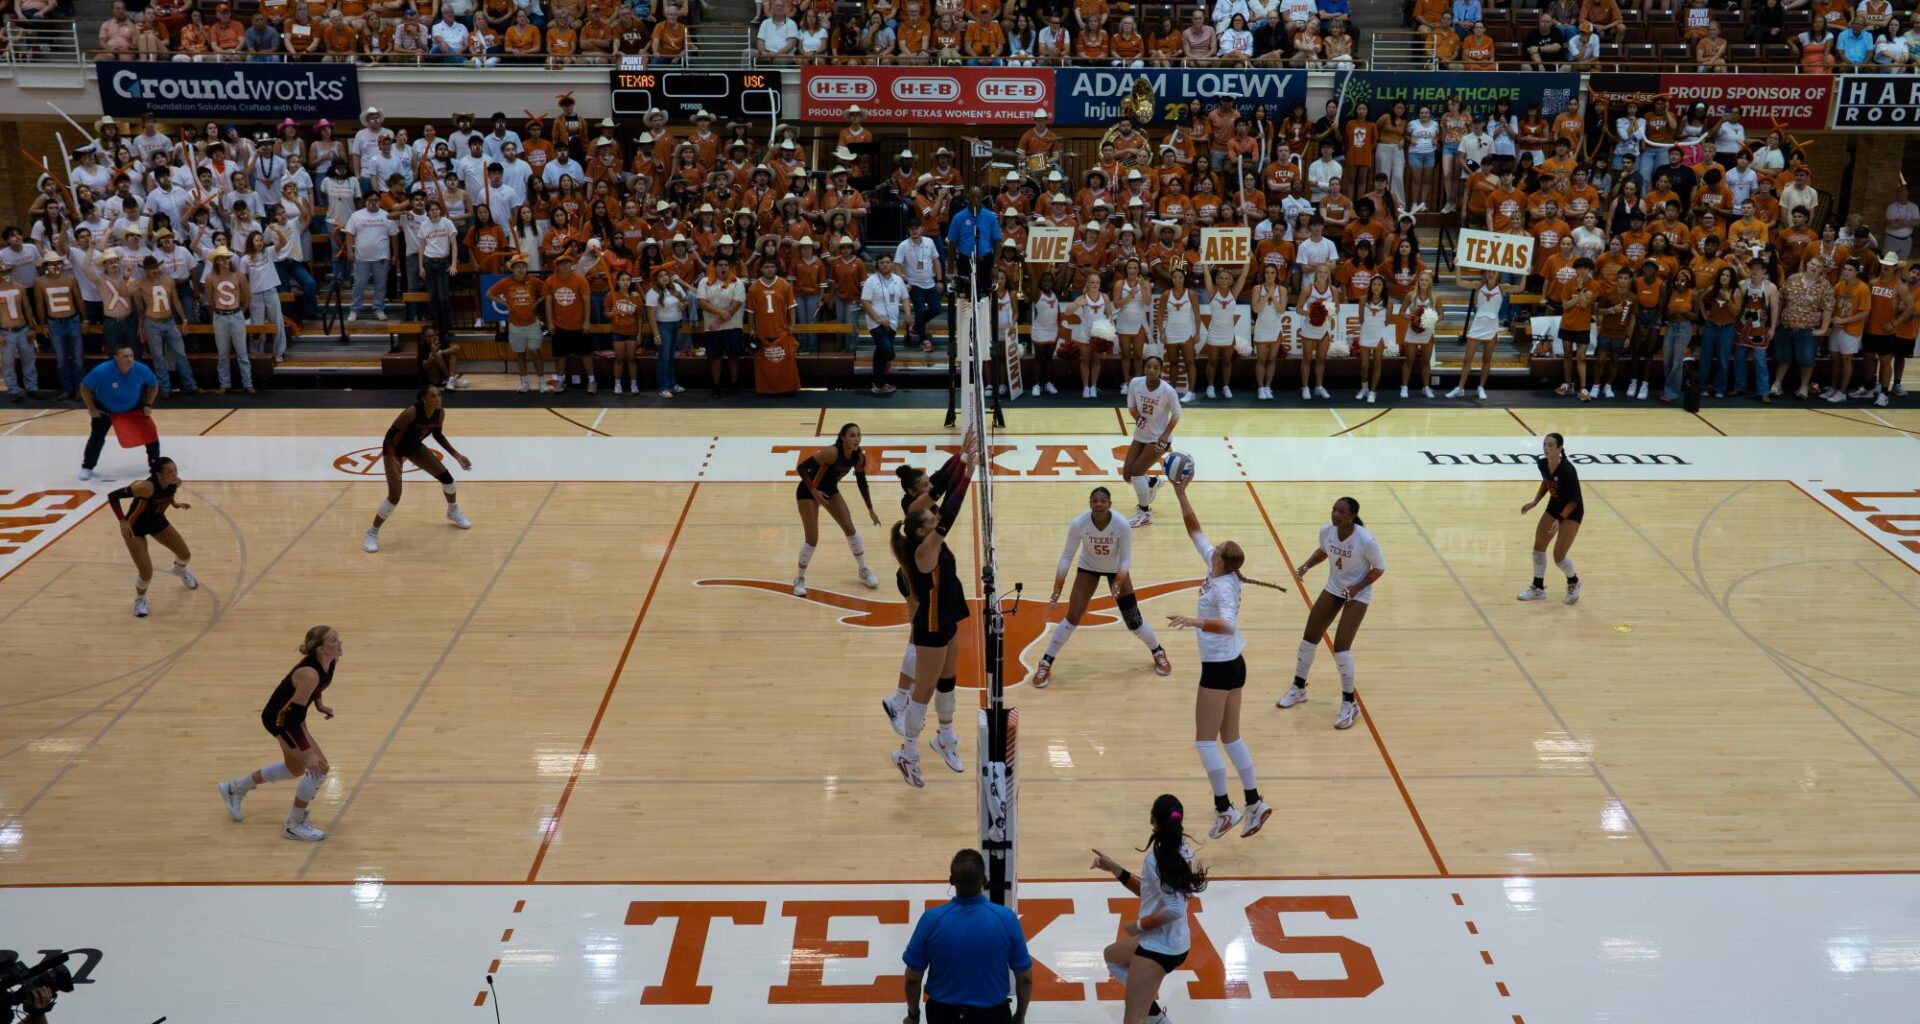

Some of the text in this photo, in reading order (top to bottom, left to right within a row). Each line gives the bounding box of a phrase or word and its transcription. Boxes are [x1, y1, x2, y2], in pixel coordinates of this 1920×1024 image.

[1690, 8, 1709, 18] POINT
[1688, 17, 1710, 27] TEXAS!
[622, 57, 642, 65] POINT
[112, 69, 344, 101] Groundworks
[619, 75, 655, 88] TEXAS
[743, 76, 765, 88] USC
[1376, 87, 1408, 100] LLH
[1668, 86, 1826, 100] PROUD SPONSOR OF
[147, 102, 318, 113] Foundation Solutions Crafted with Pride.
[680, 103, 703, 111] PERIOD
[808, 108, 843, 117] PROUD
[895, 109, 909, 118] OF
[911, 110, 943, 118] TEXAS
[945, 109, 992, 119] WOMEN'S
[1031, 237, 1068, 260] WE
[1205, 236, 1248, 261] ARE
[1466, 237, 1528, 269] TEXAS
[1871, 285, 1893, 299] TEXAS
[766, 293, 774, 314] 1
[1139, 395, 1160, 406] TEXAS
[1142, 403, 1154, 415] 23
[771, 445, 1170, 476] TEXA
[1089, 535, 1114, 545] TEXAS
[1094, 545, 1110, 556] 55
[1329, 545, 1352, 558] TEXAS
[1335, 557, 1343, 569] 4
[624, 896, 1385, 1005] TEXAS
